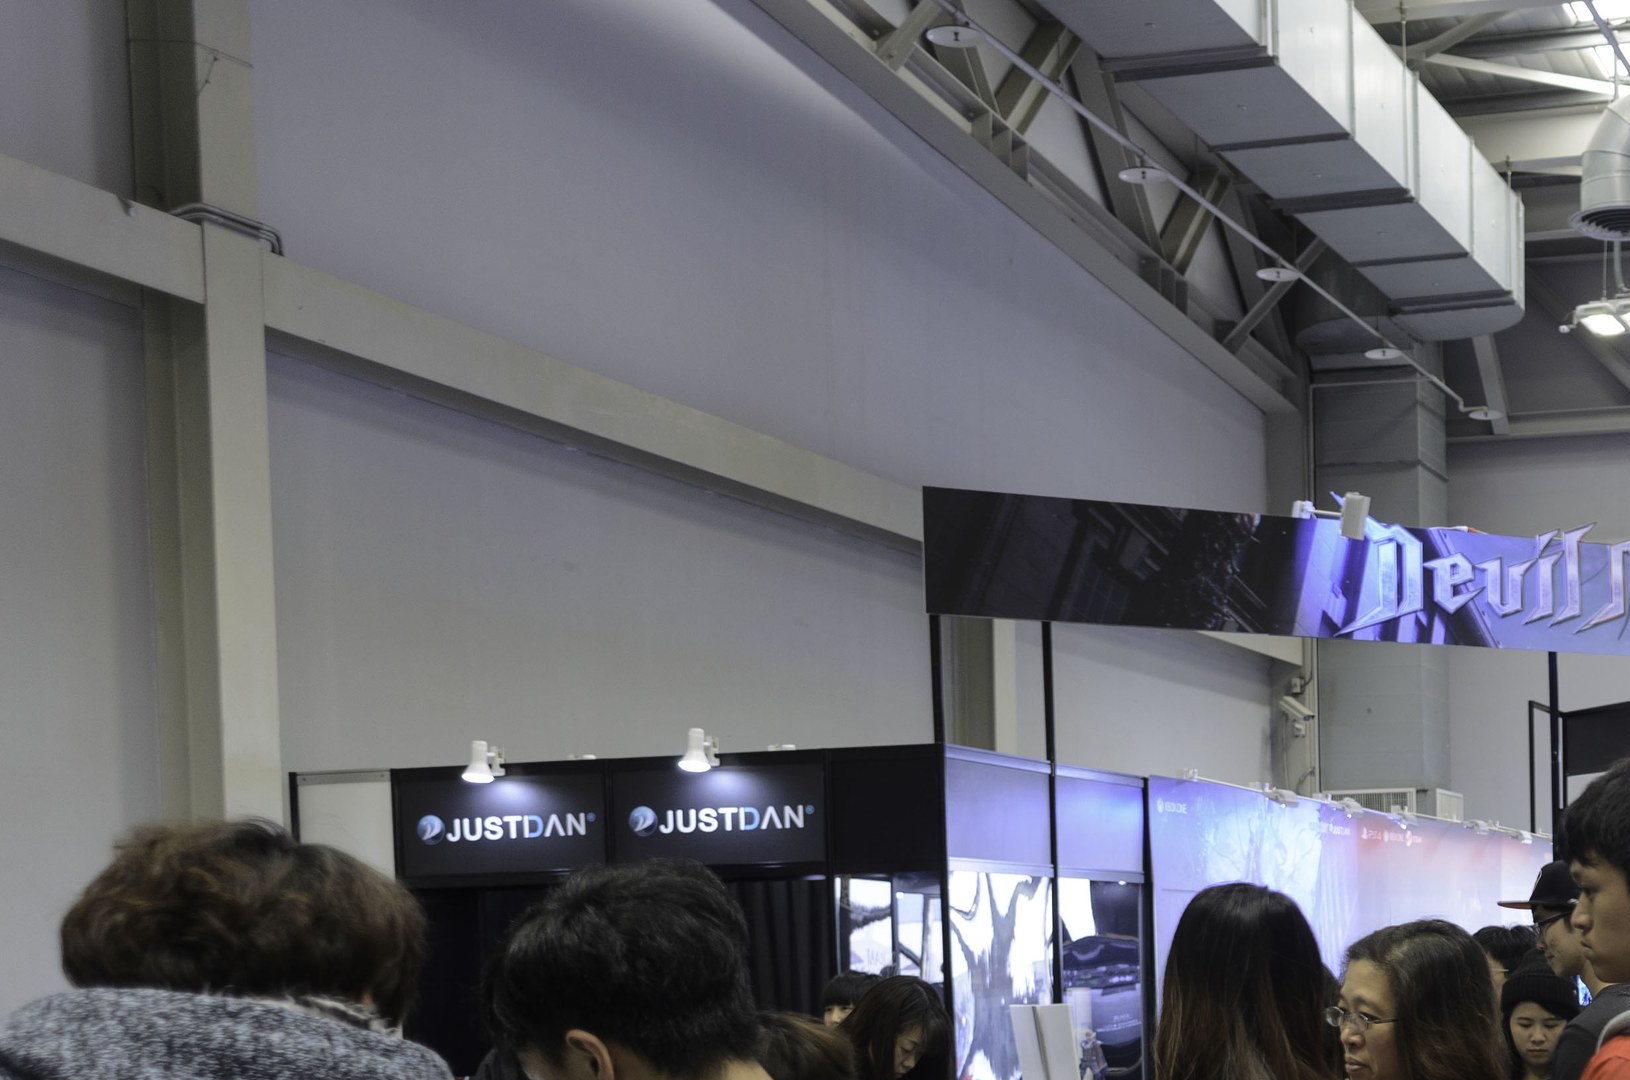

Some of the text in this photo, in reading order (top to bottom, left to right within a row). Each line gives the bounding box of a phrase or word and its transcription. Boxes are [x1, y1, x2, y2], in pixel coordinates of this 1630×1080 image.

[1330, 491, 1598, 637] Devil
[446, 811, 588, 843] JUSTDAN
[659, 804, 806, 834] JUSTDAN
